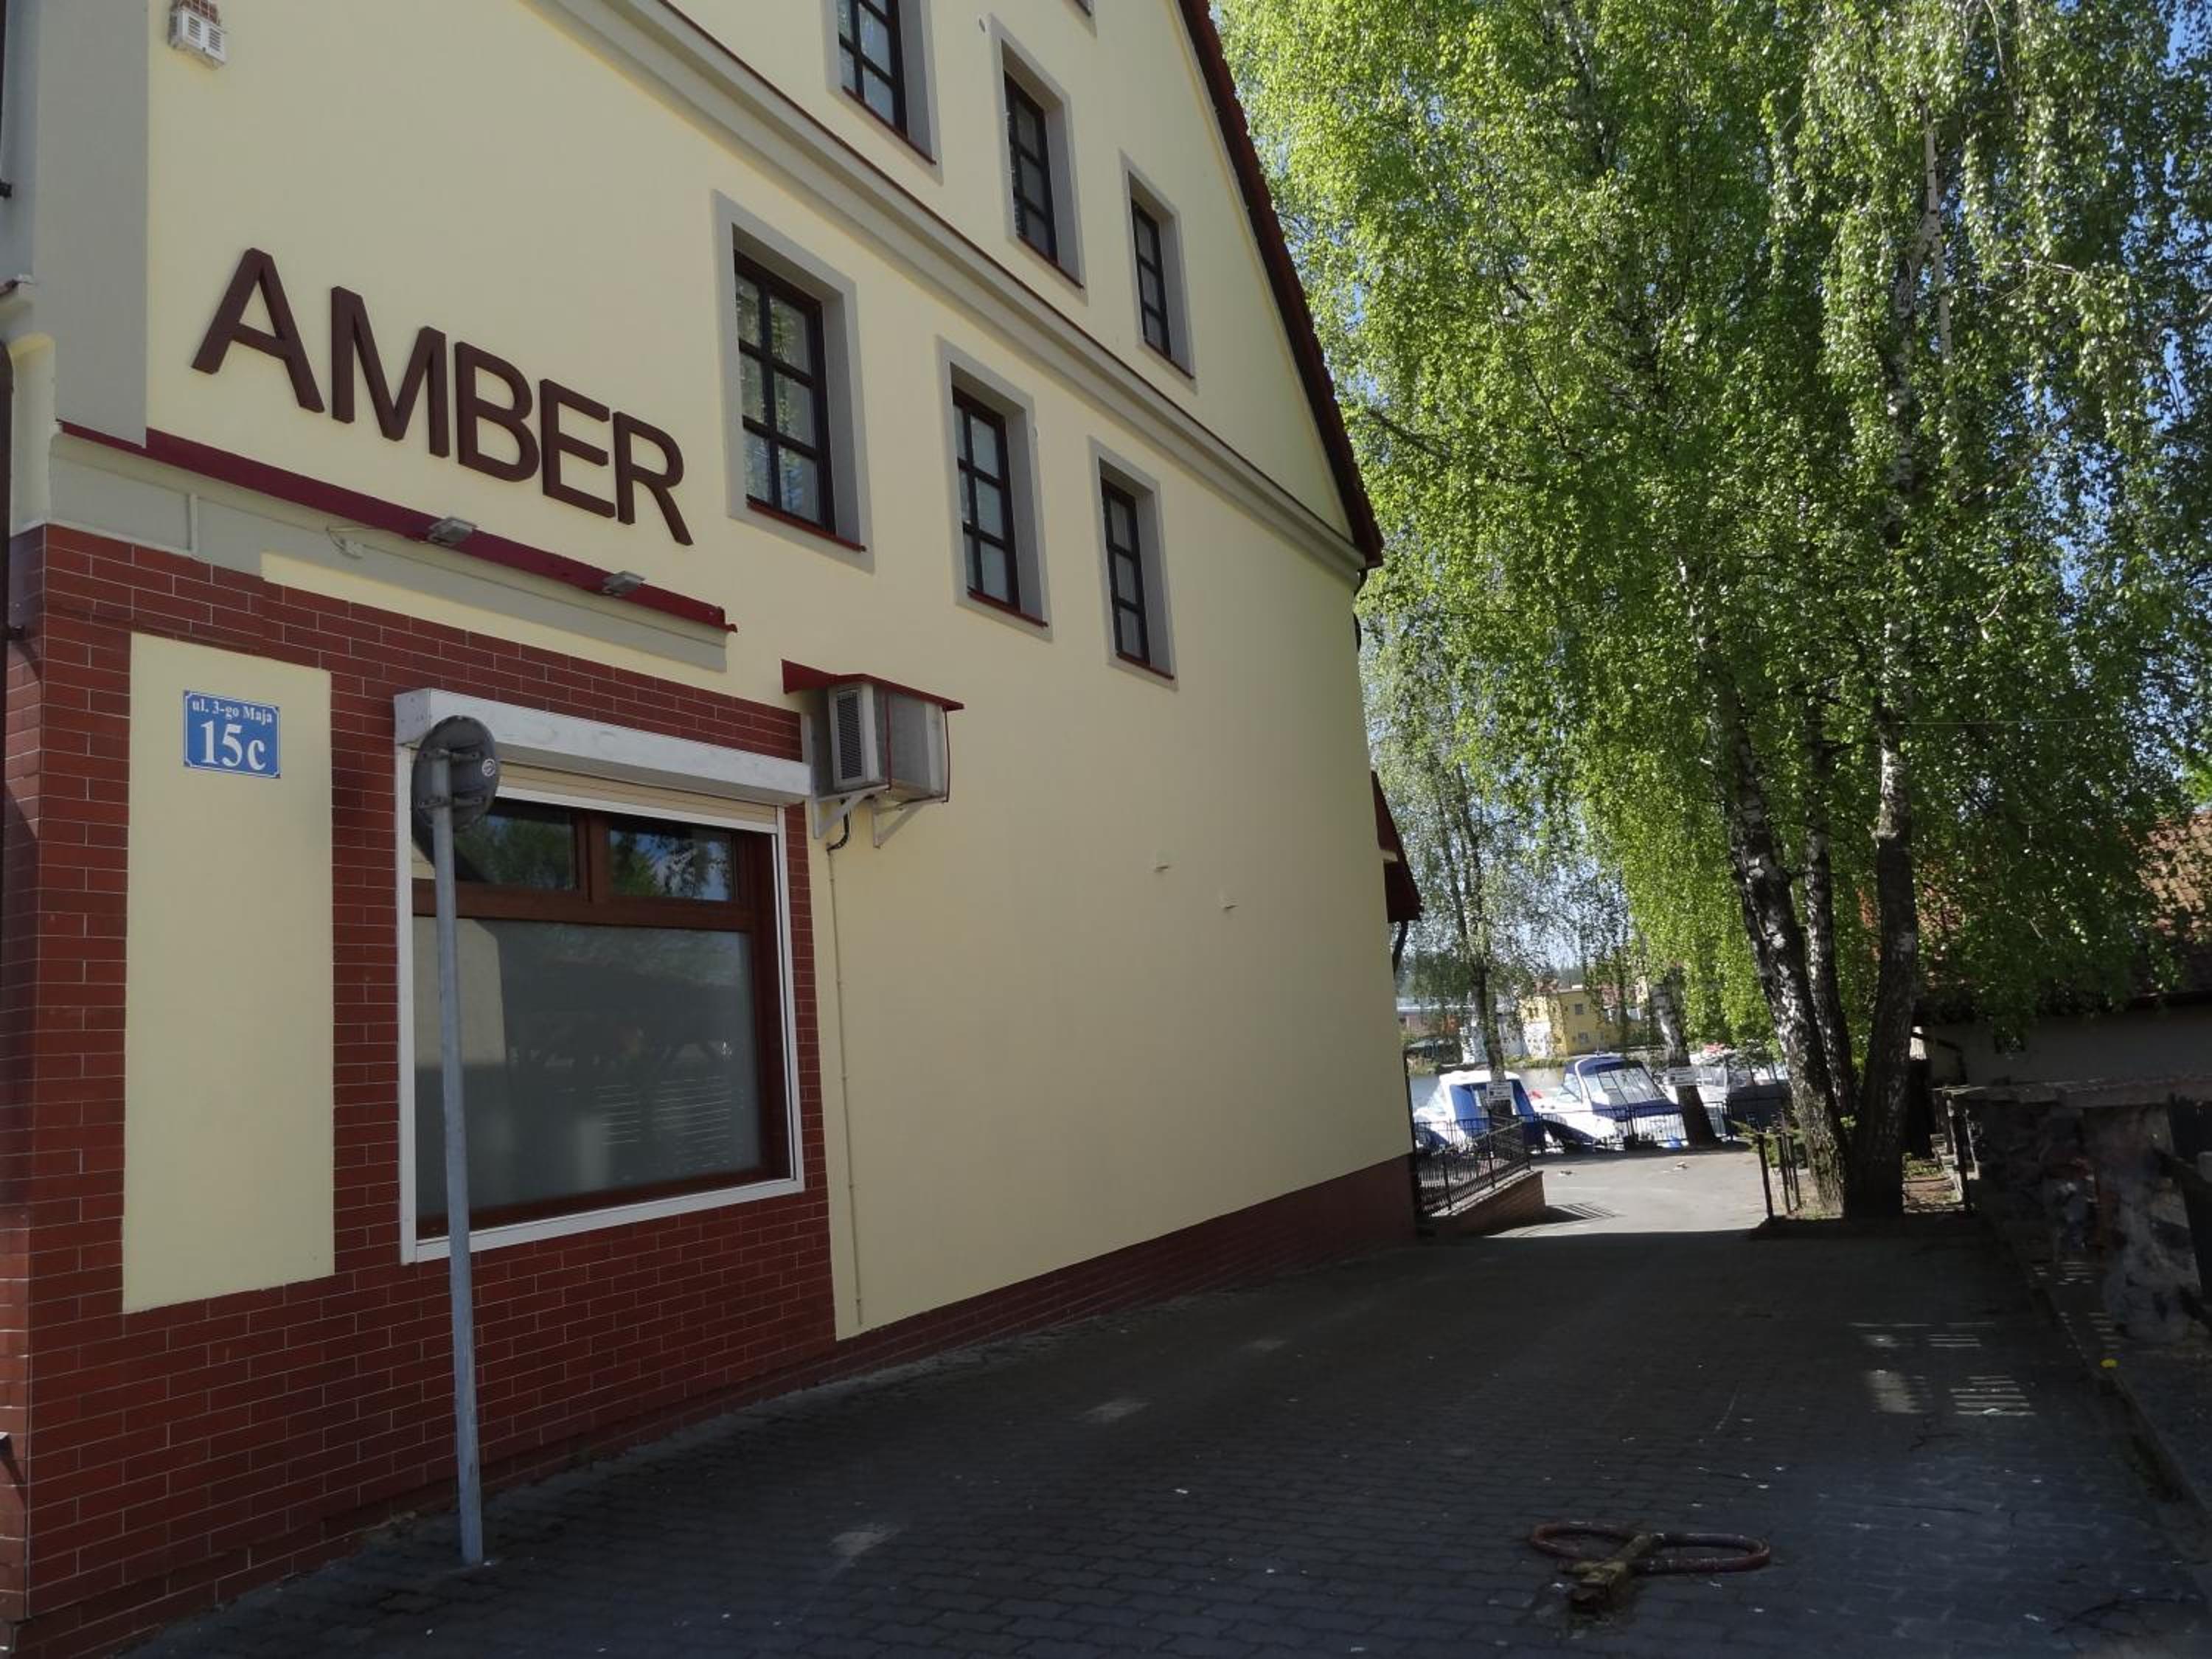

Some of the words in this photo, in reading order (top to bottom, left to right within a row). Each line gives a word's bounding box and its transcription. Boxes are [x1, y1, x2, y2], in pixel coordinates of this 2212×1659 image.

[191, 247, 694, 546] AMBER
[192, 699, 209, 713] ul.
[212, 700, 240, 720] 3-go
[243, 706, 272, 726] Maja
[201, 720, 266, 771] 15c
